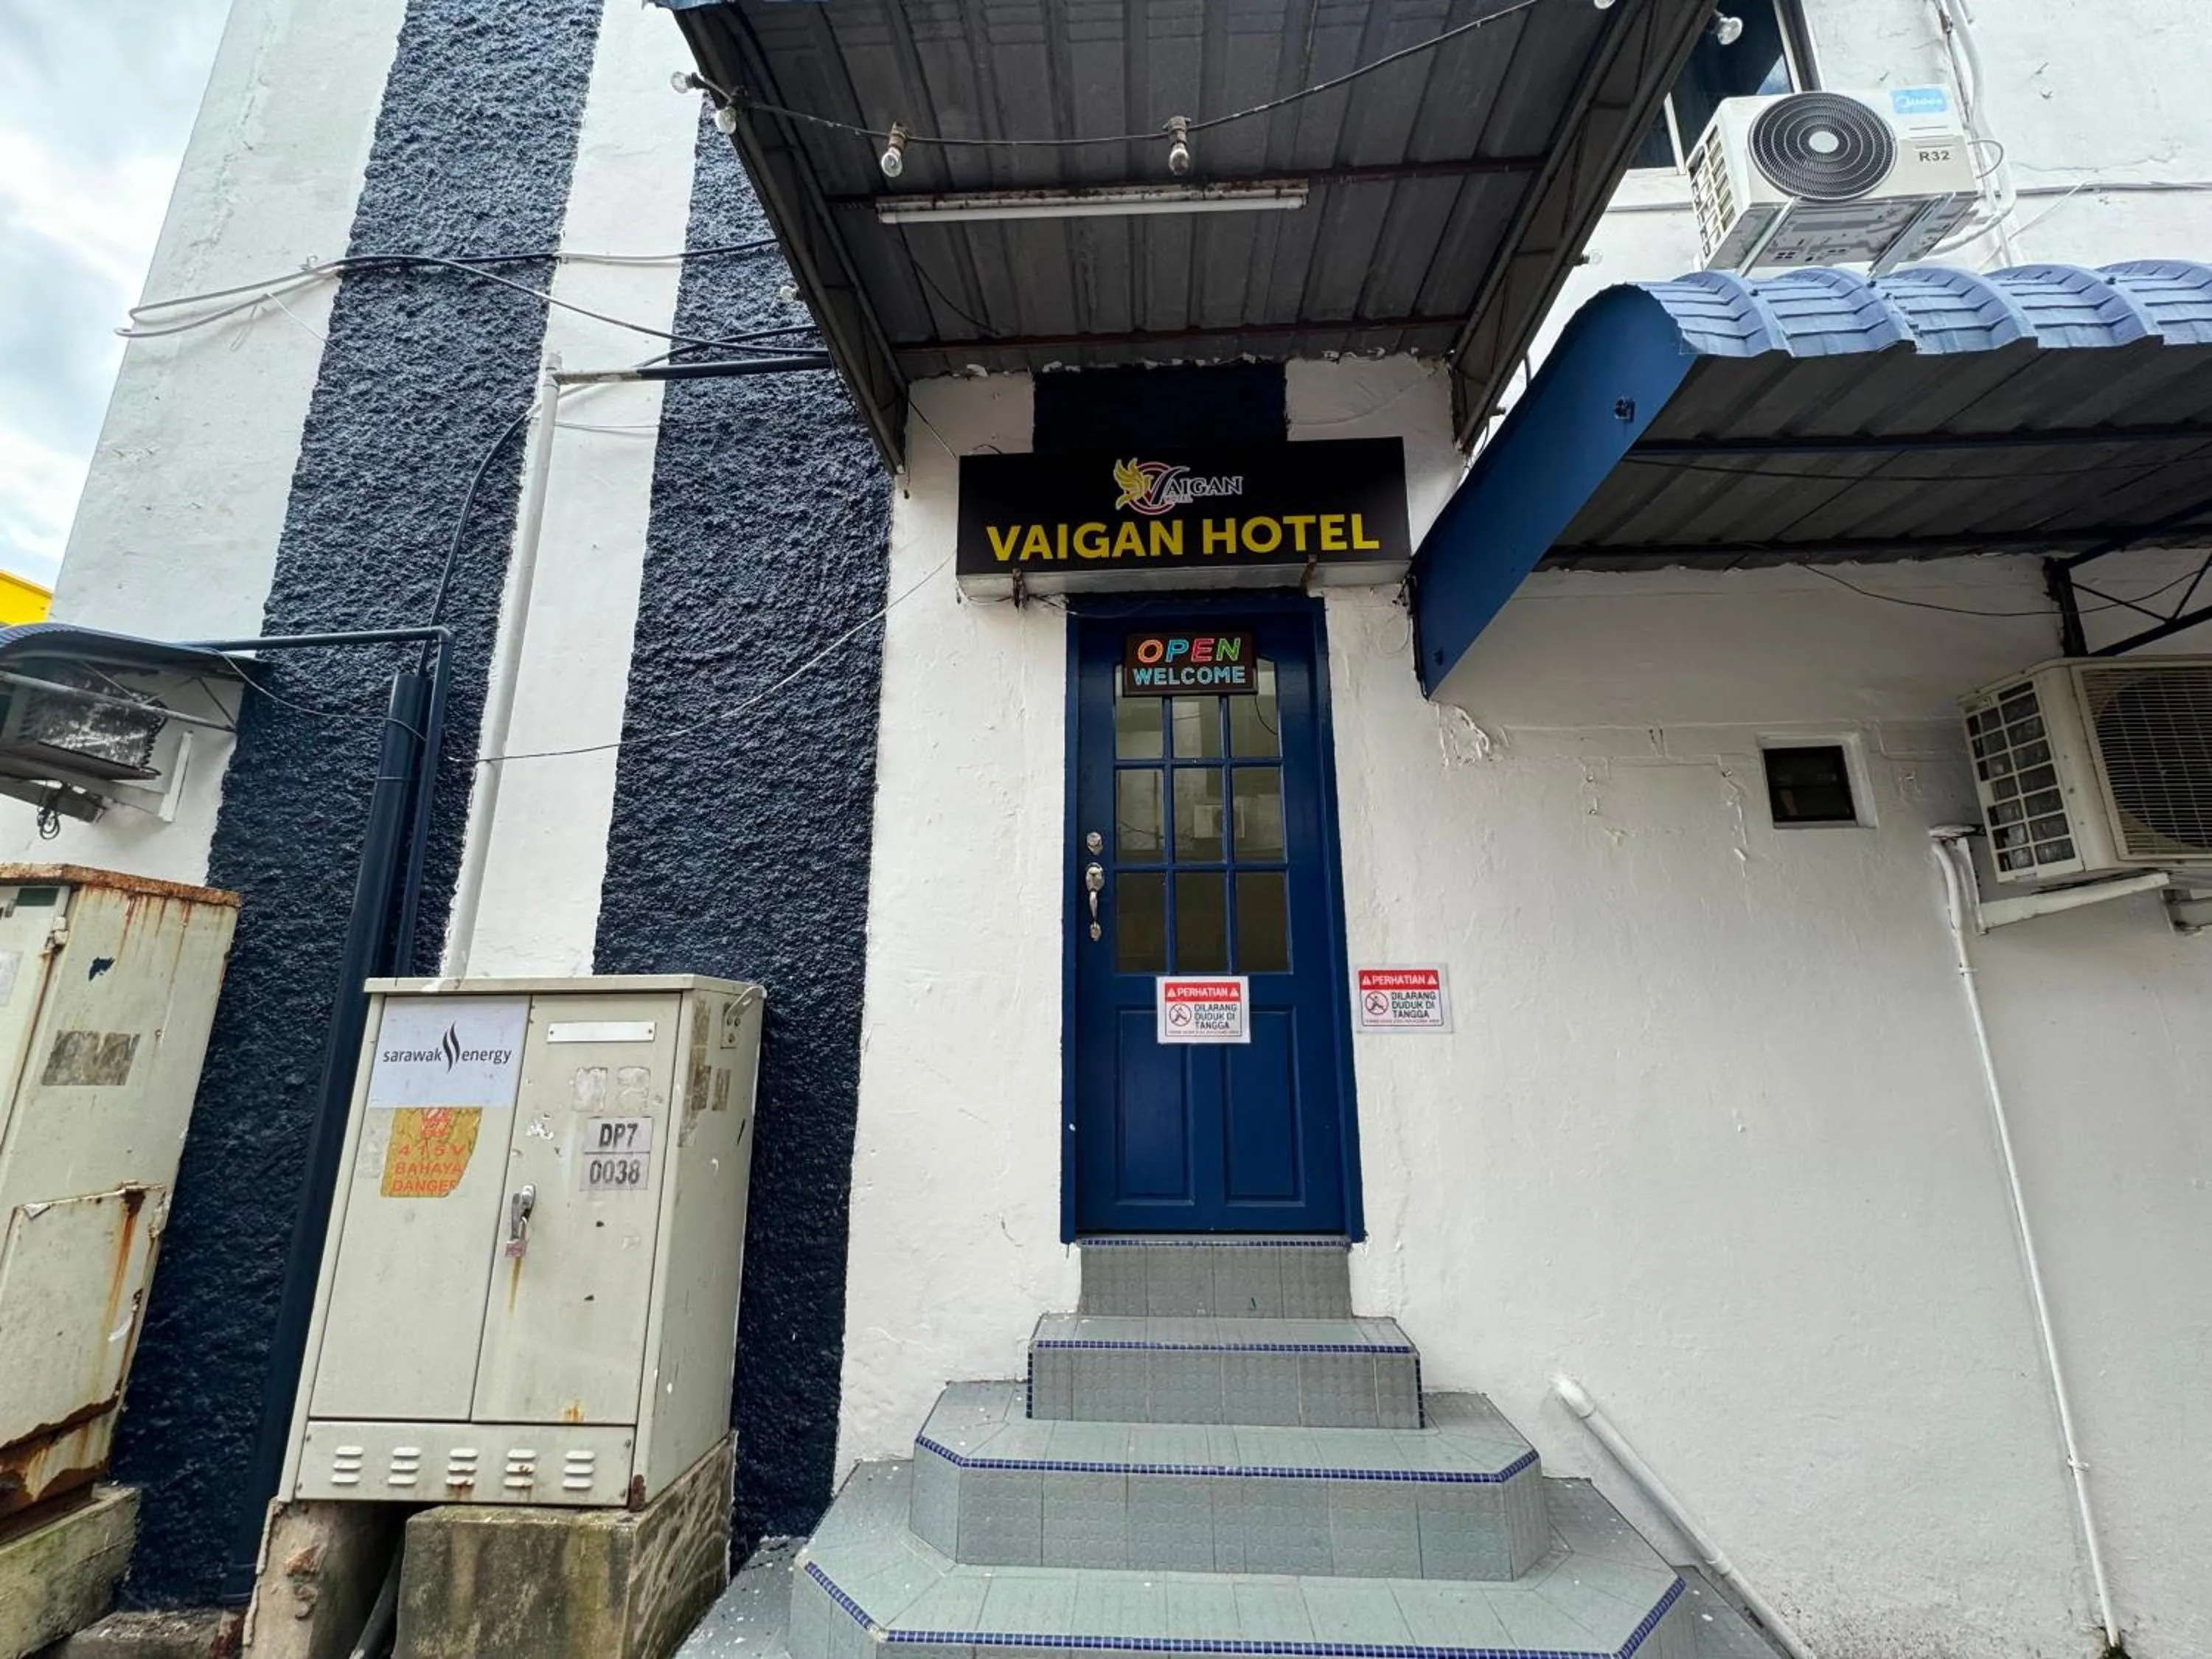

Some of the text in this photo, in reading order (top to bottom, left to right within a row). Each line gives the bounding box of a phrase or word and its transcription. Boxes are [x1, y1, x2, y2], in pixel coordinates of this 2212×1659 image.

[1919, 150, 1951, 162] R32
[986, 512, 1380, 562] VAIGAN HOTEL
[1137, 637, 1242, 663] OPEN
[1132, 666, 1246, 686] WELCOME
[1372, 974, 1426, 985] PERHATIAN
[1178, 987, 1228, 998] PERHATIAN
[1391, 991, 1436, 1001] DILARANG
[1194, 1004, 1238, 1012] DILARANG
[1391, 1001, 1436, 1009] DUDUK DI
[1194, 1012, 1236, 1021] DUDUK DI
[1392, 1009, 1430, 1018] TANGGA
[1194, 1021, 1231, 1030] TANGGA
[382, 1047, 512, 1064] sarawak energy
[598, 1123, 639, 1147] DP7
[394, 1161, 464, 1175] BAHAYA
[589, 1159, 641, 1185] 0038
